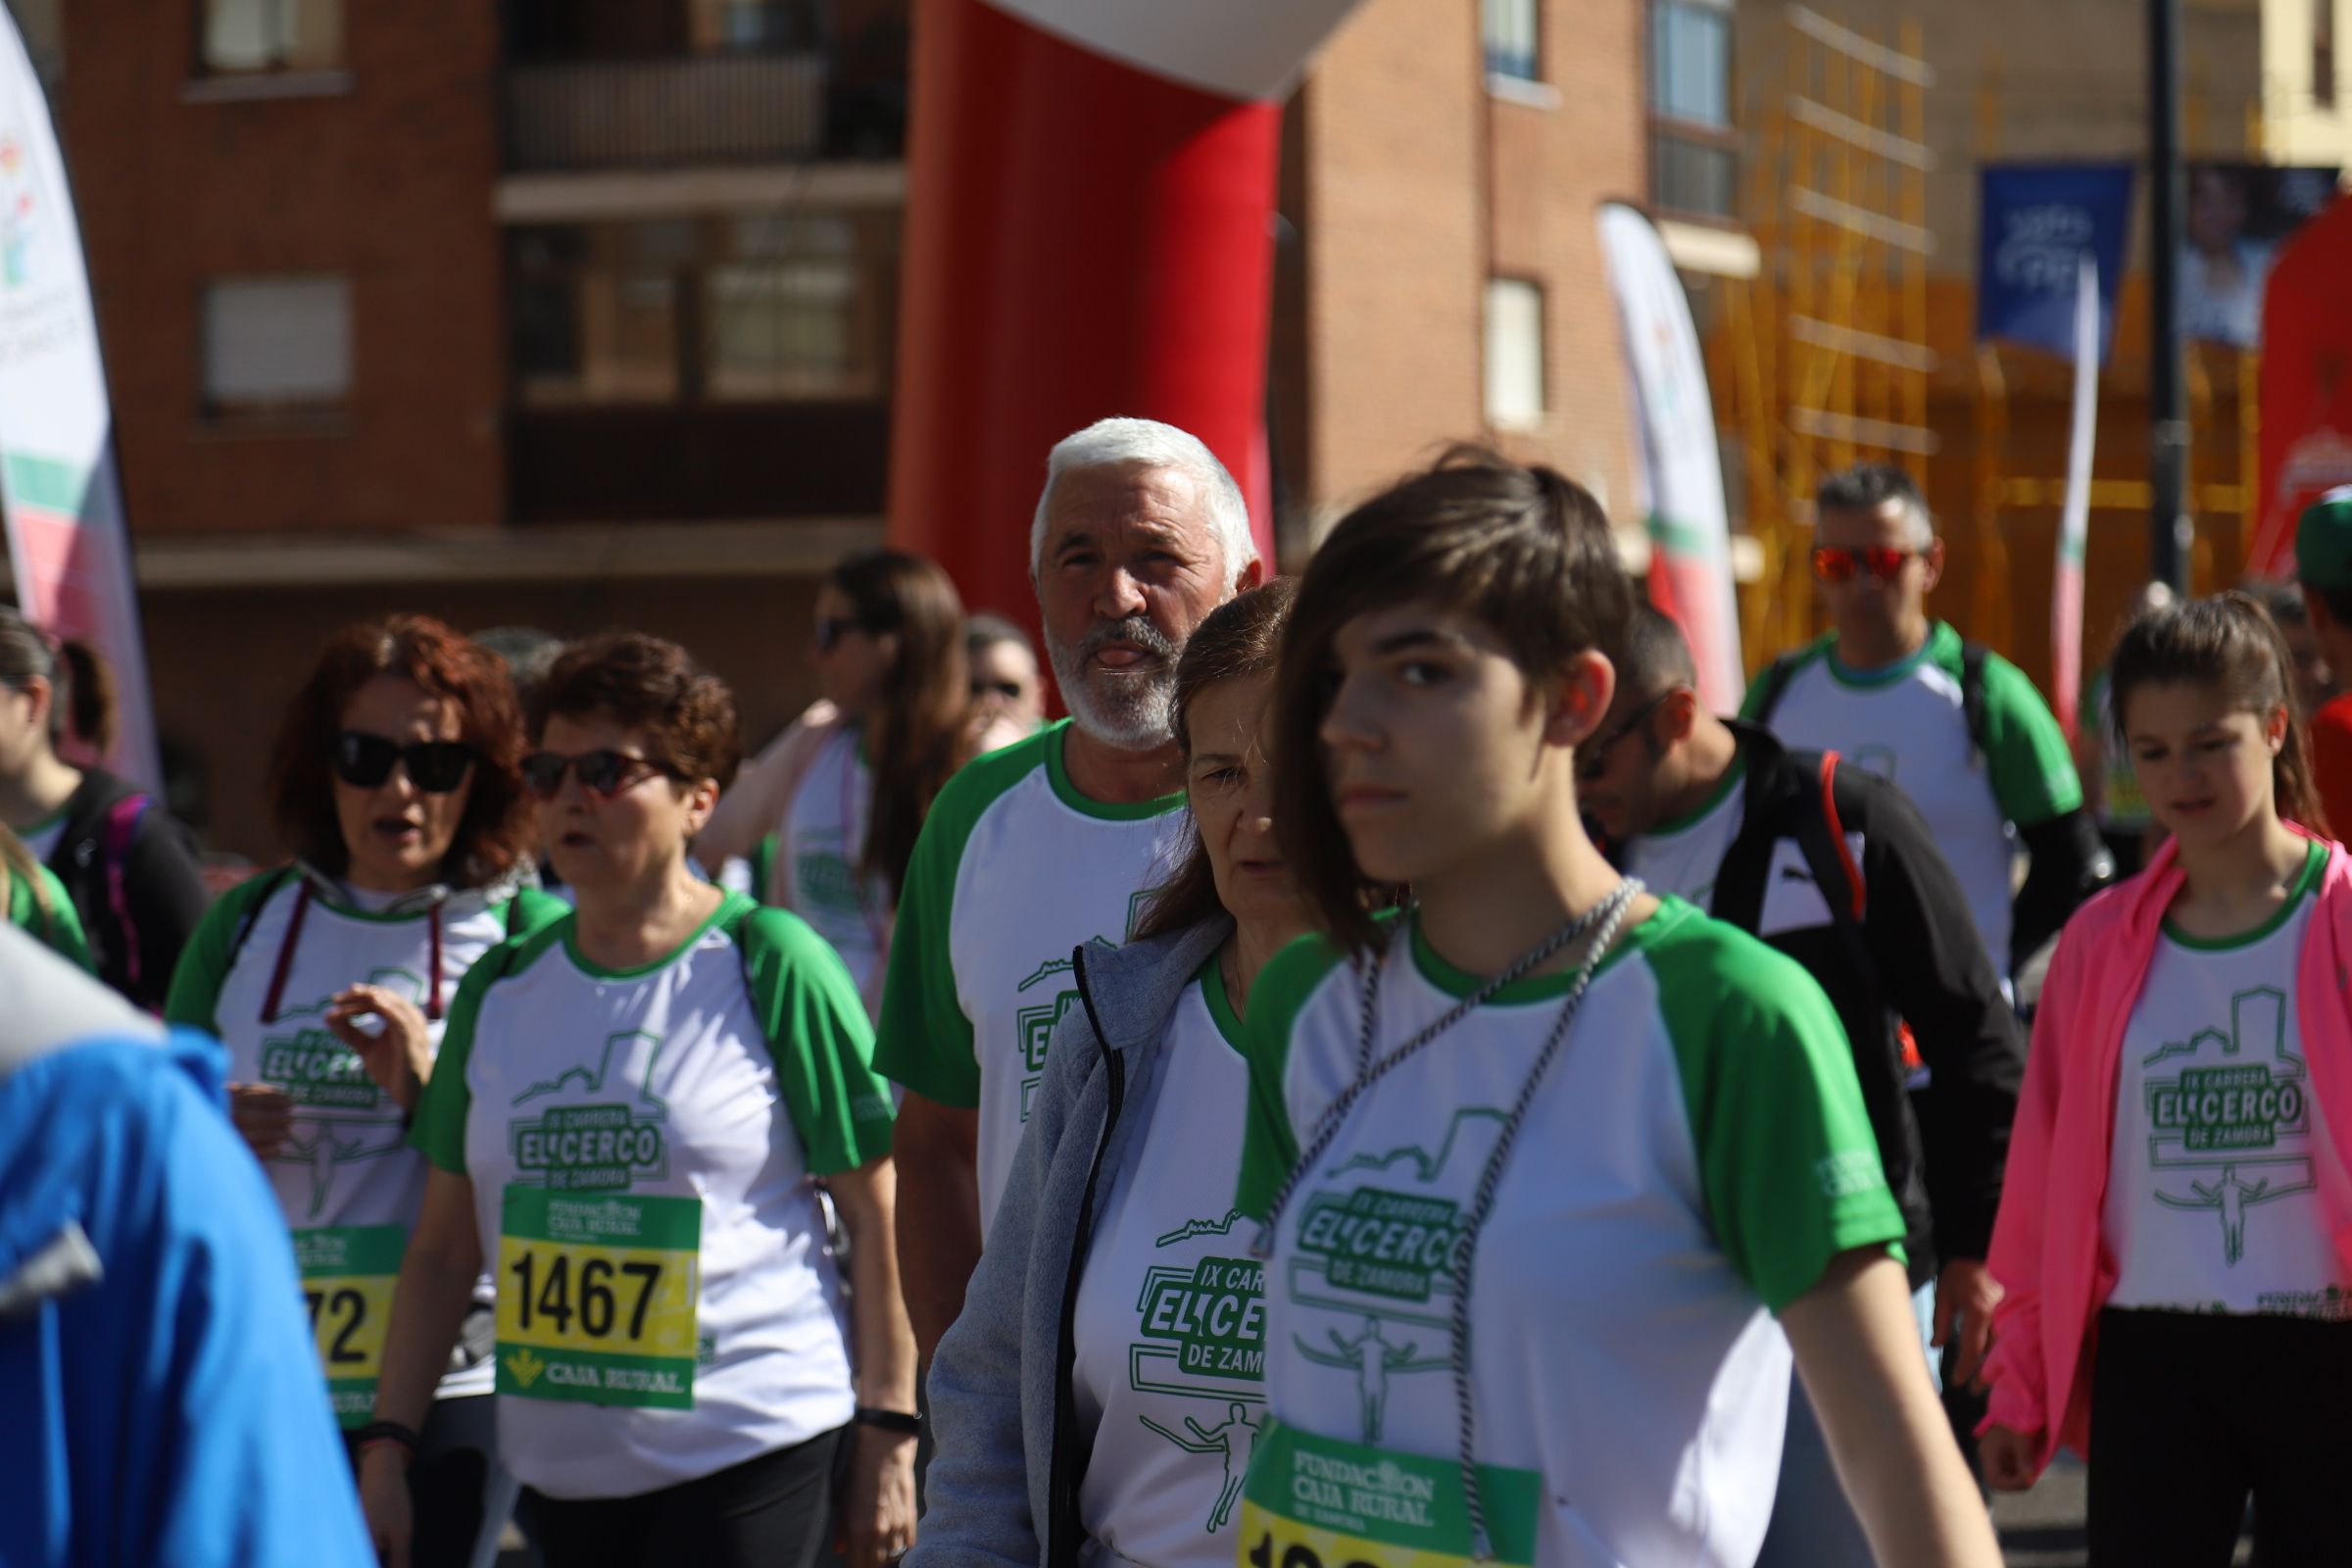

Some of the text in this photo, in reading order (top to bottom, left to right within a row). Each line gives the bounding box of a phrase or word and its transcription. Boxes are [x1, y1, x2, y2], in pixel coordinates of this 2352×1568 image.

[2204, 1068, 2267, 1089] CARRERA
[2158, 1086, 2298, 1124] EL CERCO
[560, 1127, 658, 1164] CERCO
[2189, 1124, 2271, 1147] DE ZAMORA
[1200, 1265, 1223, 1287] IX
[512, 1250, 662, 1341] 1467
[1149, 1289, 1193, 1333] EL
[1187, 1344, 1215, 1368] DE
[605, 1367, 686, 1394] RURAL
[1294, 1475, 1436, 1527] CAJA RURAL
